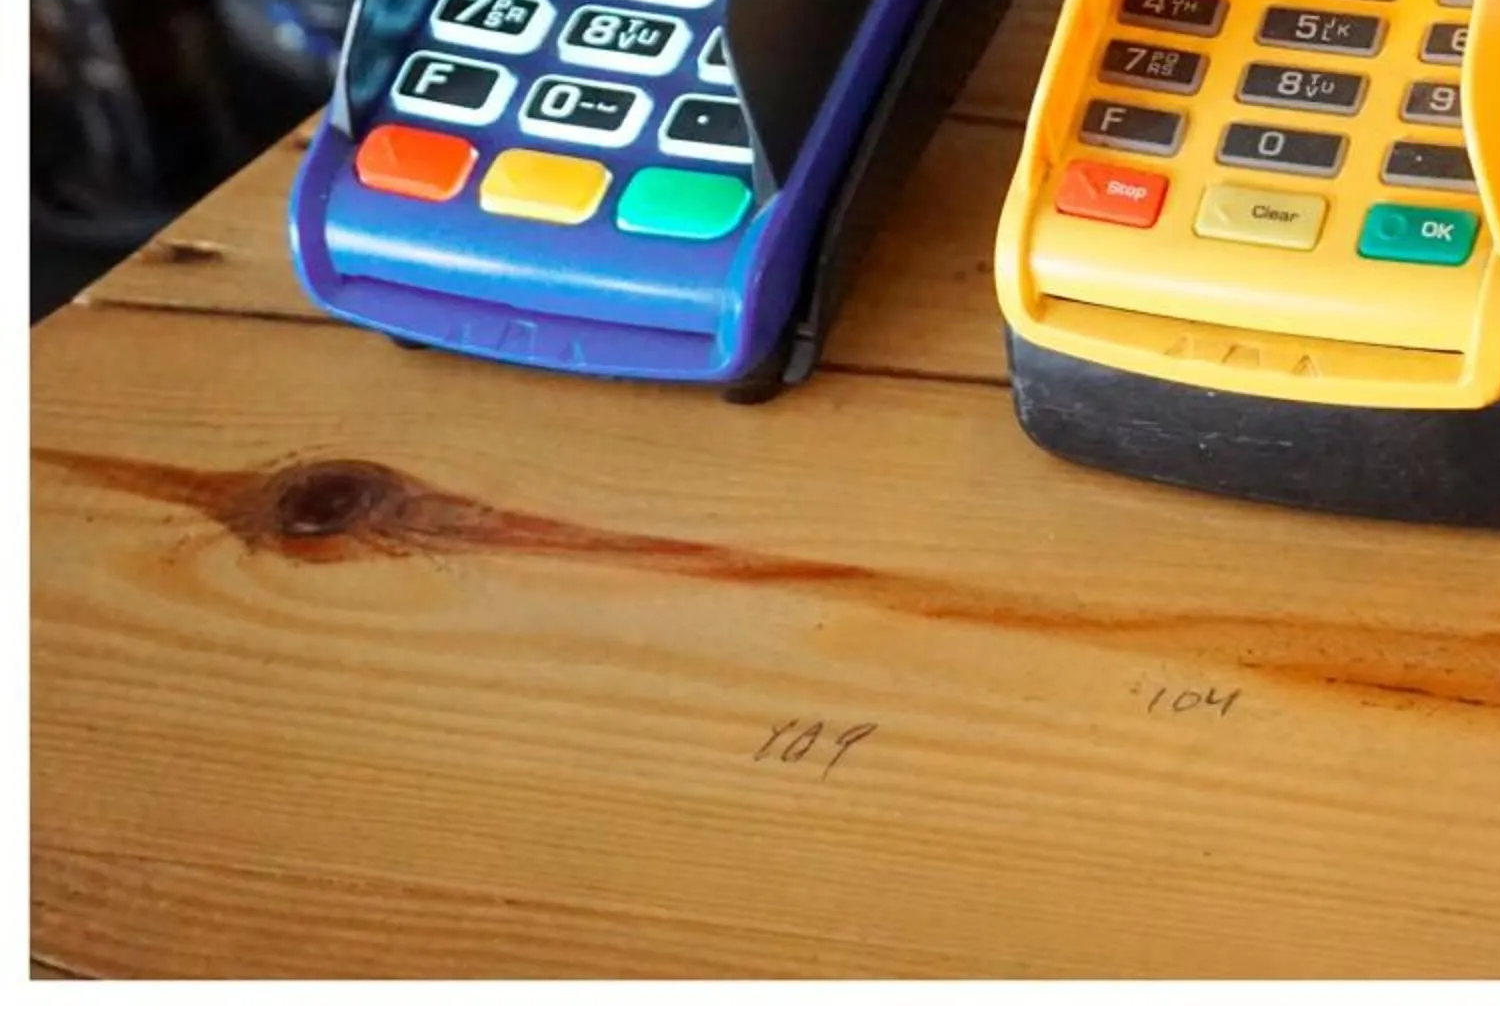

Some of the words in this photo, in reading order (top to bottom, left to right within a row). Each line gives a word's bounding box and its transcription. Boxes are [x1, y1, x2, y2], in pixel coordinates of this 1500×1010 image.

[581, 15, 620, 45] 8
[1295, 13, 1321, 39] 5
[1124, 48, 1147, 71] 7
[415, 62, 455, 95] F
[1277, 71, 1304, 95] 8
[1429, 86, 1456, 111] 9
[1100, 108, 1127, 132] F
[1258, 131, 1286, 156] 0
[1106, 180, 1149, 201] Stop
[1251, 205, 1300, 224] Clear
[1421, 220, 1454, 241] OK
[1146, 687, 1241, 718] 104
